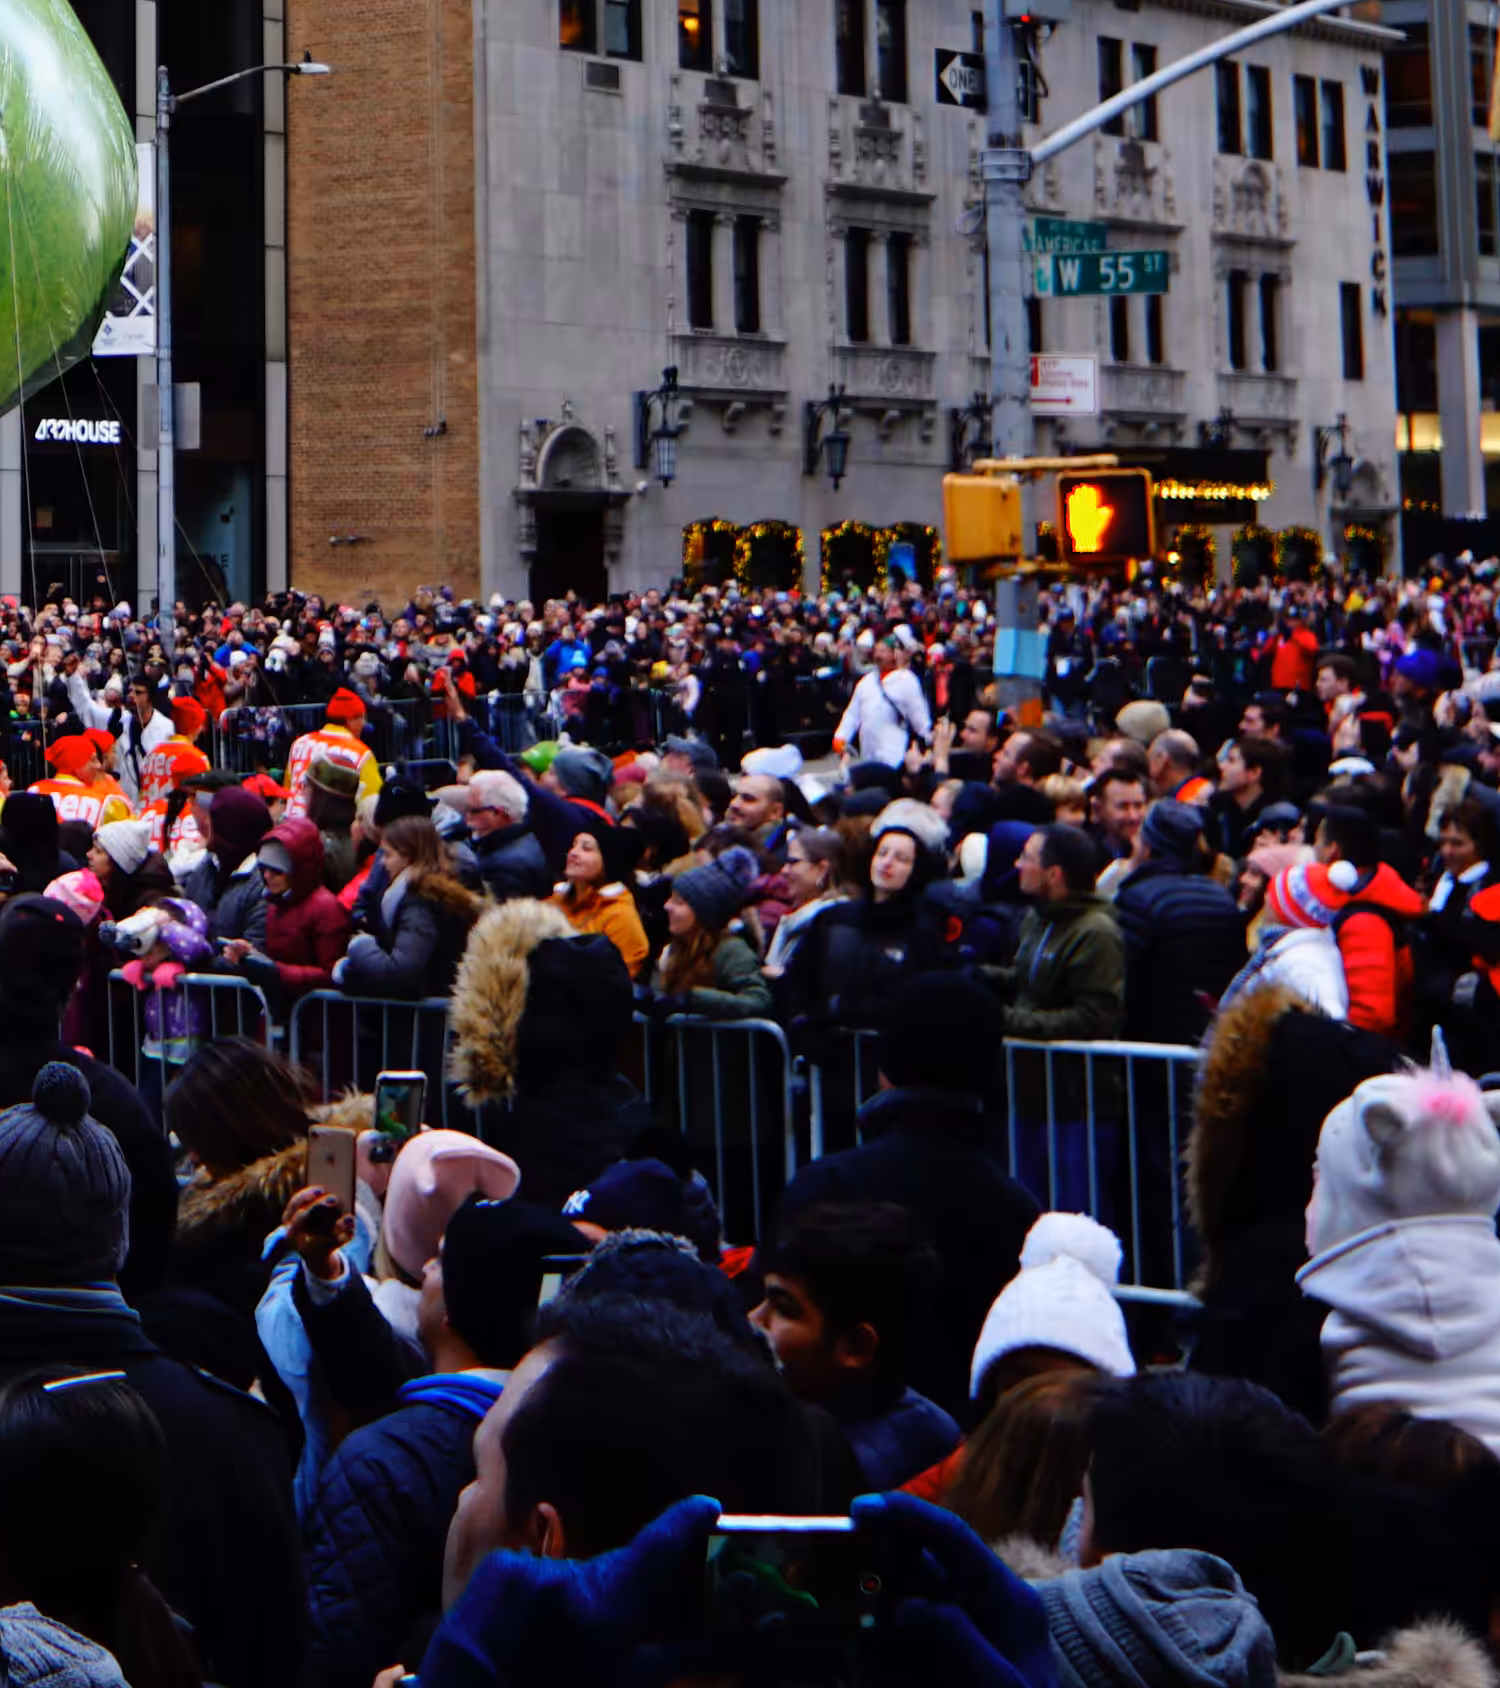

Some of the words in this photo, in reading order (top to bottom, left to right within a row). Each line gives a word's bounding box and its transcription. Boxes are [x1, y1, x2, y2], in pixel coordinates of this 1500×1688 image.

[948, 67, 976, 89] ONE
[1360, 64, 1387, 316] WARWICK
[1059, 258, 1081, 291] W
[1100, 255, 1136, 290] 55
[1144, 253, 1163, 272] ST
